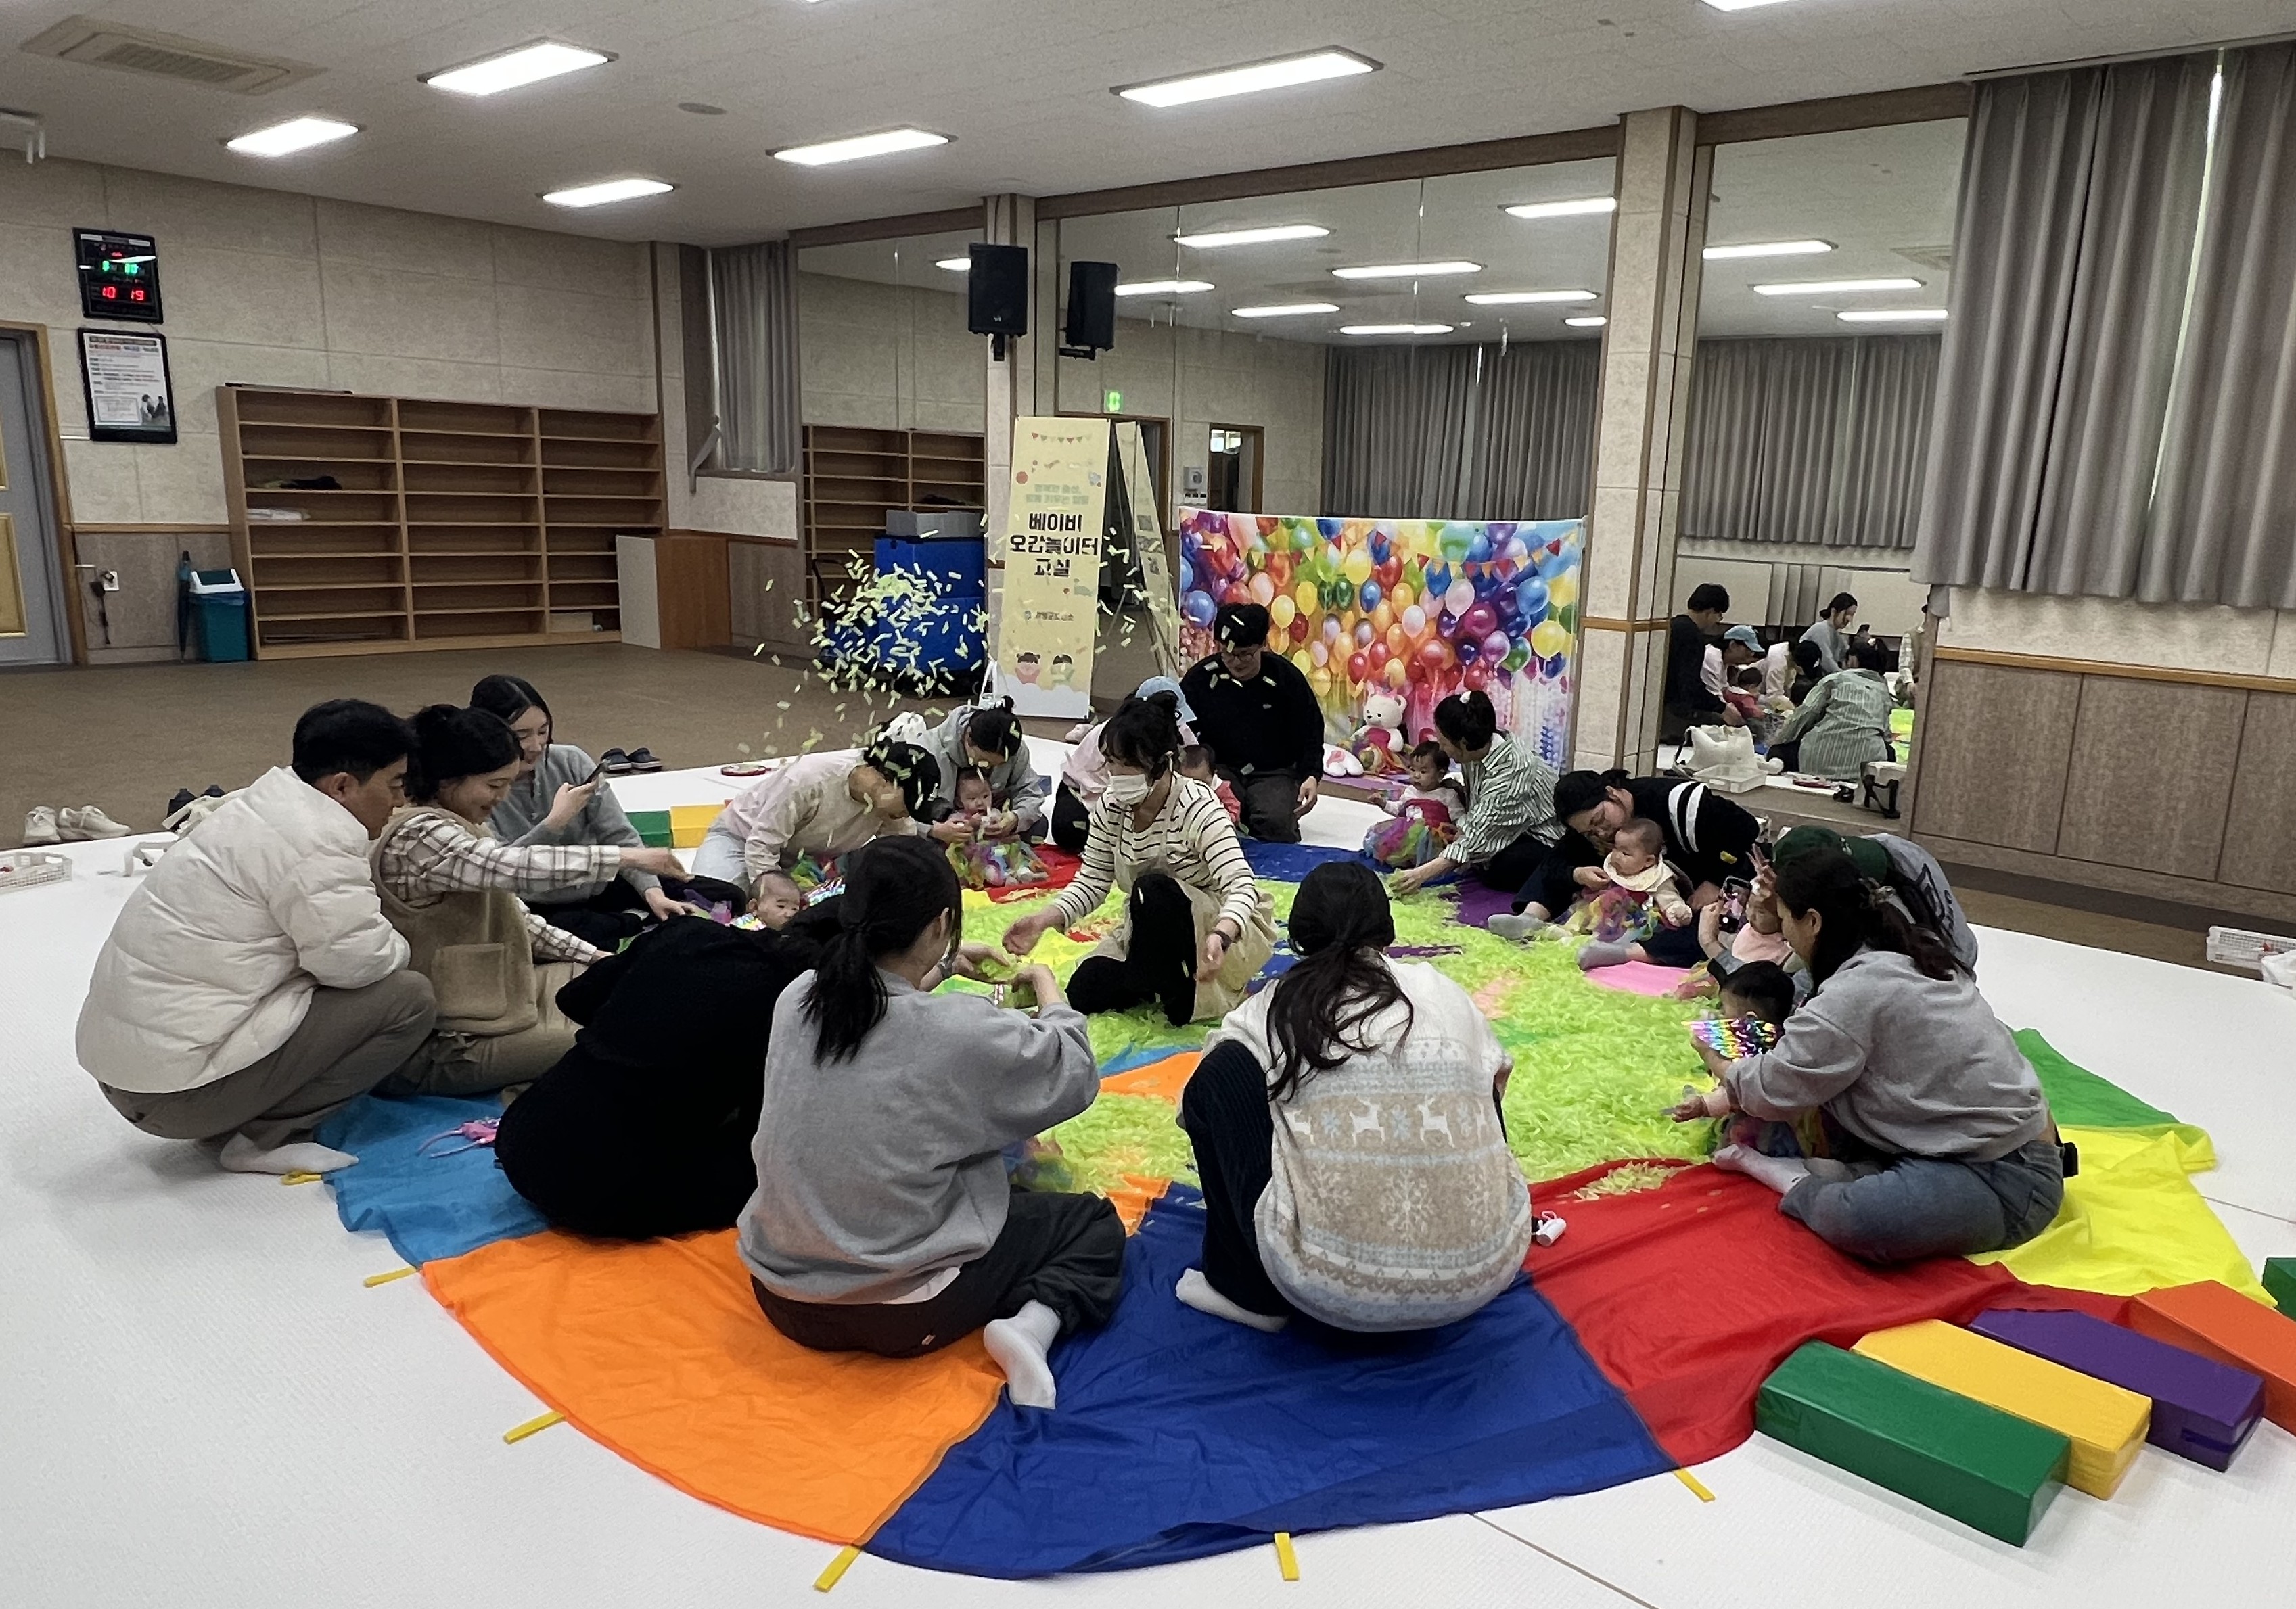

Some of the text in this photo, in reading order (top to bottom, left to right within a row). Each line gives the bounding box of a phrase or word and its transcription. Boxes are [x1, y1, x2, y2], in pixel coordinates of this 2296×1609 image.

[102, 286, 145, 301] 10 19
[1028, 512, 1082, 532] 베이비
[1009, 534, 1099, 555] 오감놀이터
[1034, 558, 1070, 578] 교실
